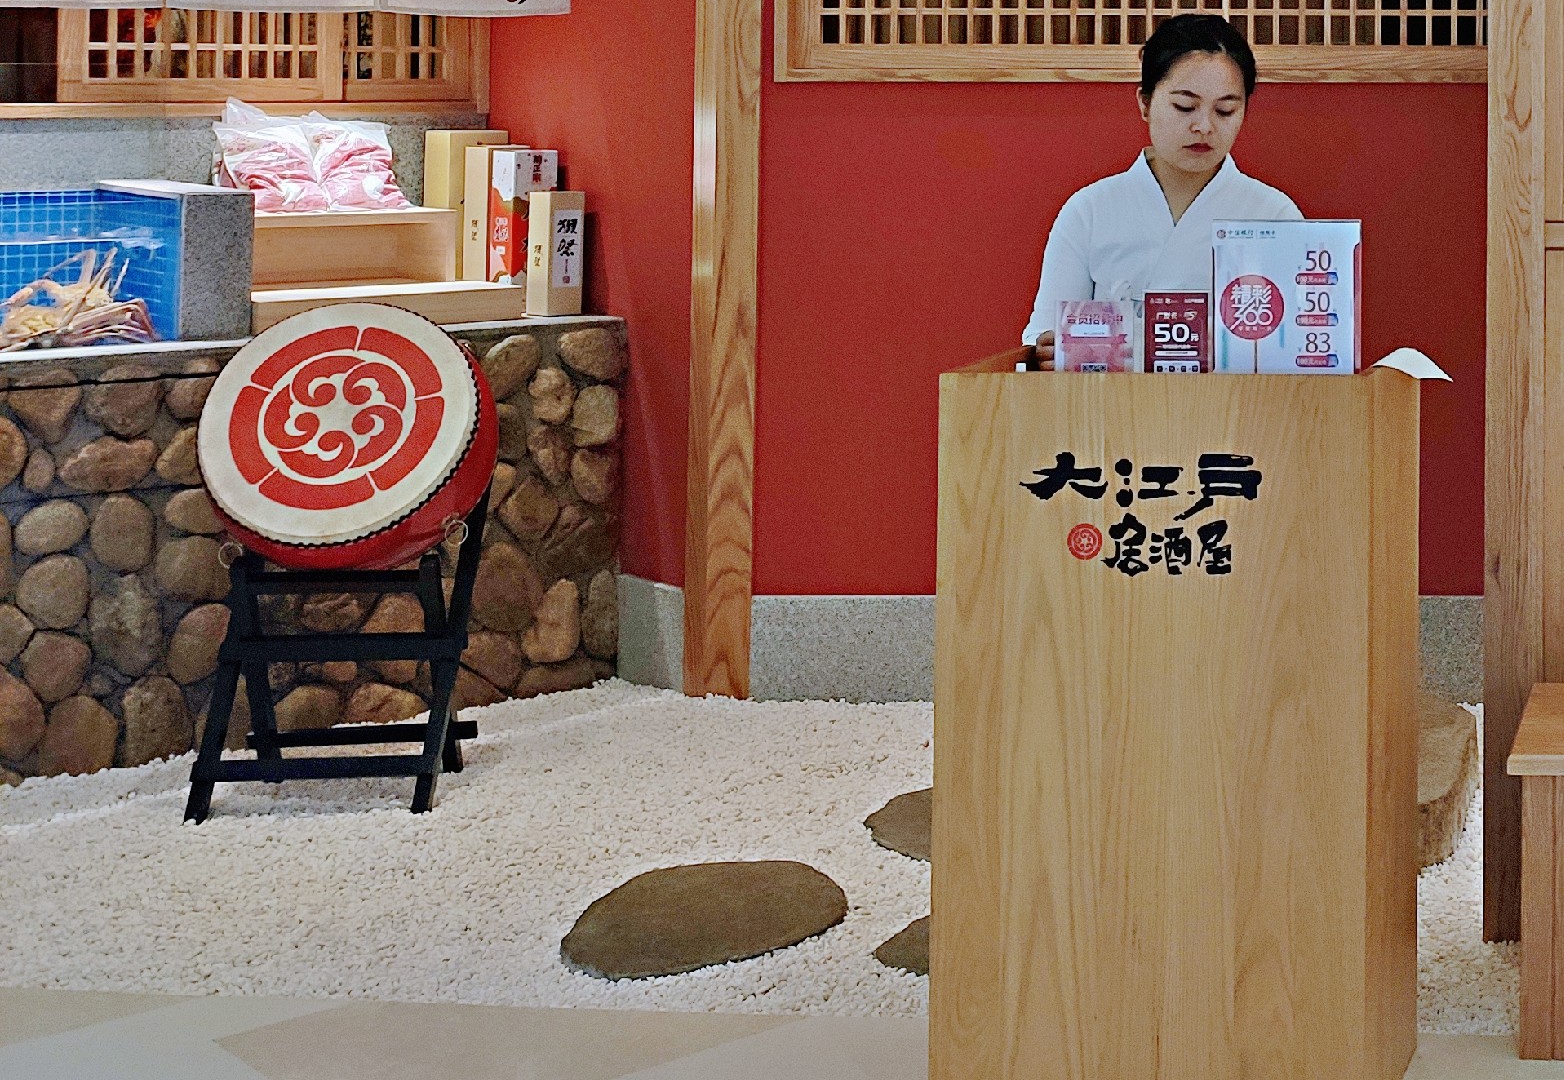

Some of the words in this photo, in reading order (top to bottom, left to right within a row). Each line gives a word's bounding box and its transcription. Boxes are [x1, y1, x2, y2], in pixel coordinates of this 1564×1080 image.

[1305, 250, 1332, 271] 50
[1303, 291, 1331, 313] 50
[1305, 332, 1332, 354] 83
[1101, 512, 1232, 578] 居酒屋
